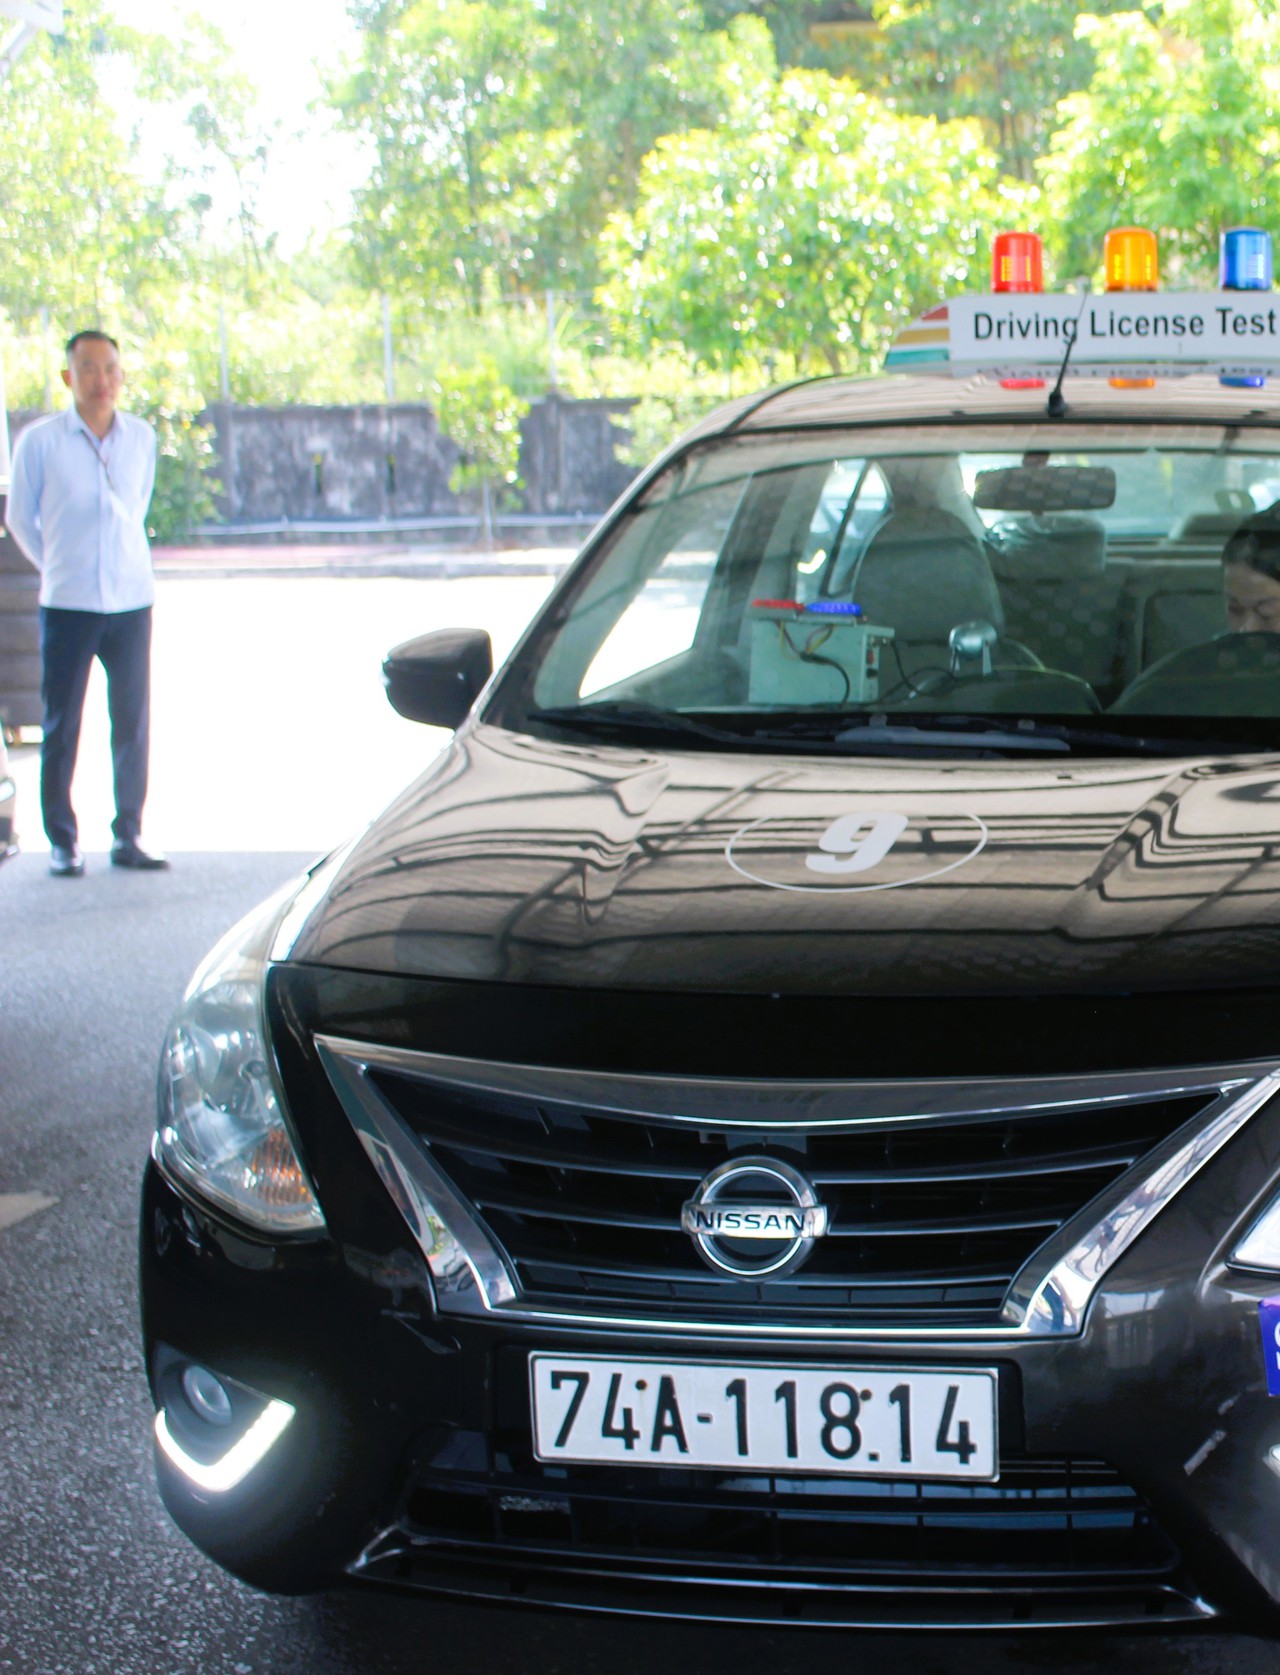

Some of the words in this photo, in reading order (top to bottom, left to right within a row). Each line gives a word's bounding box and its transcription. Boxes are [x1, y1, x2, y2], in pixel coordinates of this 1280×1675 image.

[974, 311, 1078, 345] Driving
[1090, 309, 1204, 337] License
[1215, 307, 1277, 336] Test
[804, 811, 910, 875] 9
[695, 1210, 805, 1231] NISSAN
[550, 1369, 978, 1465] 74A-118.14
